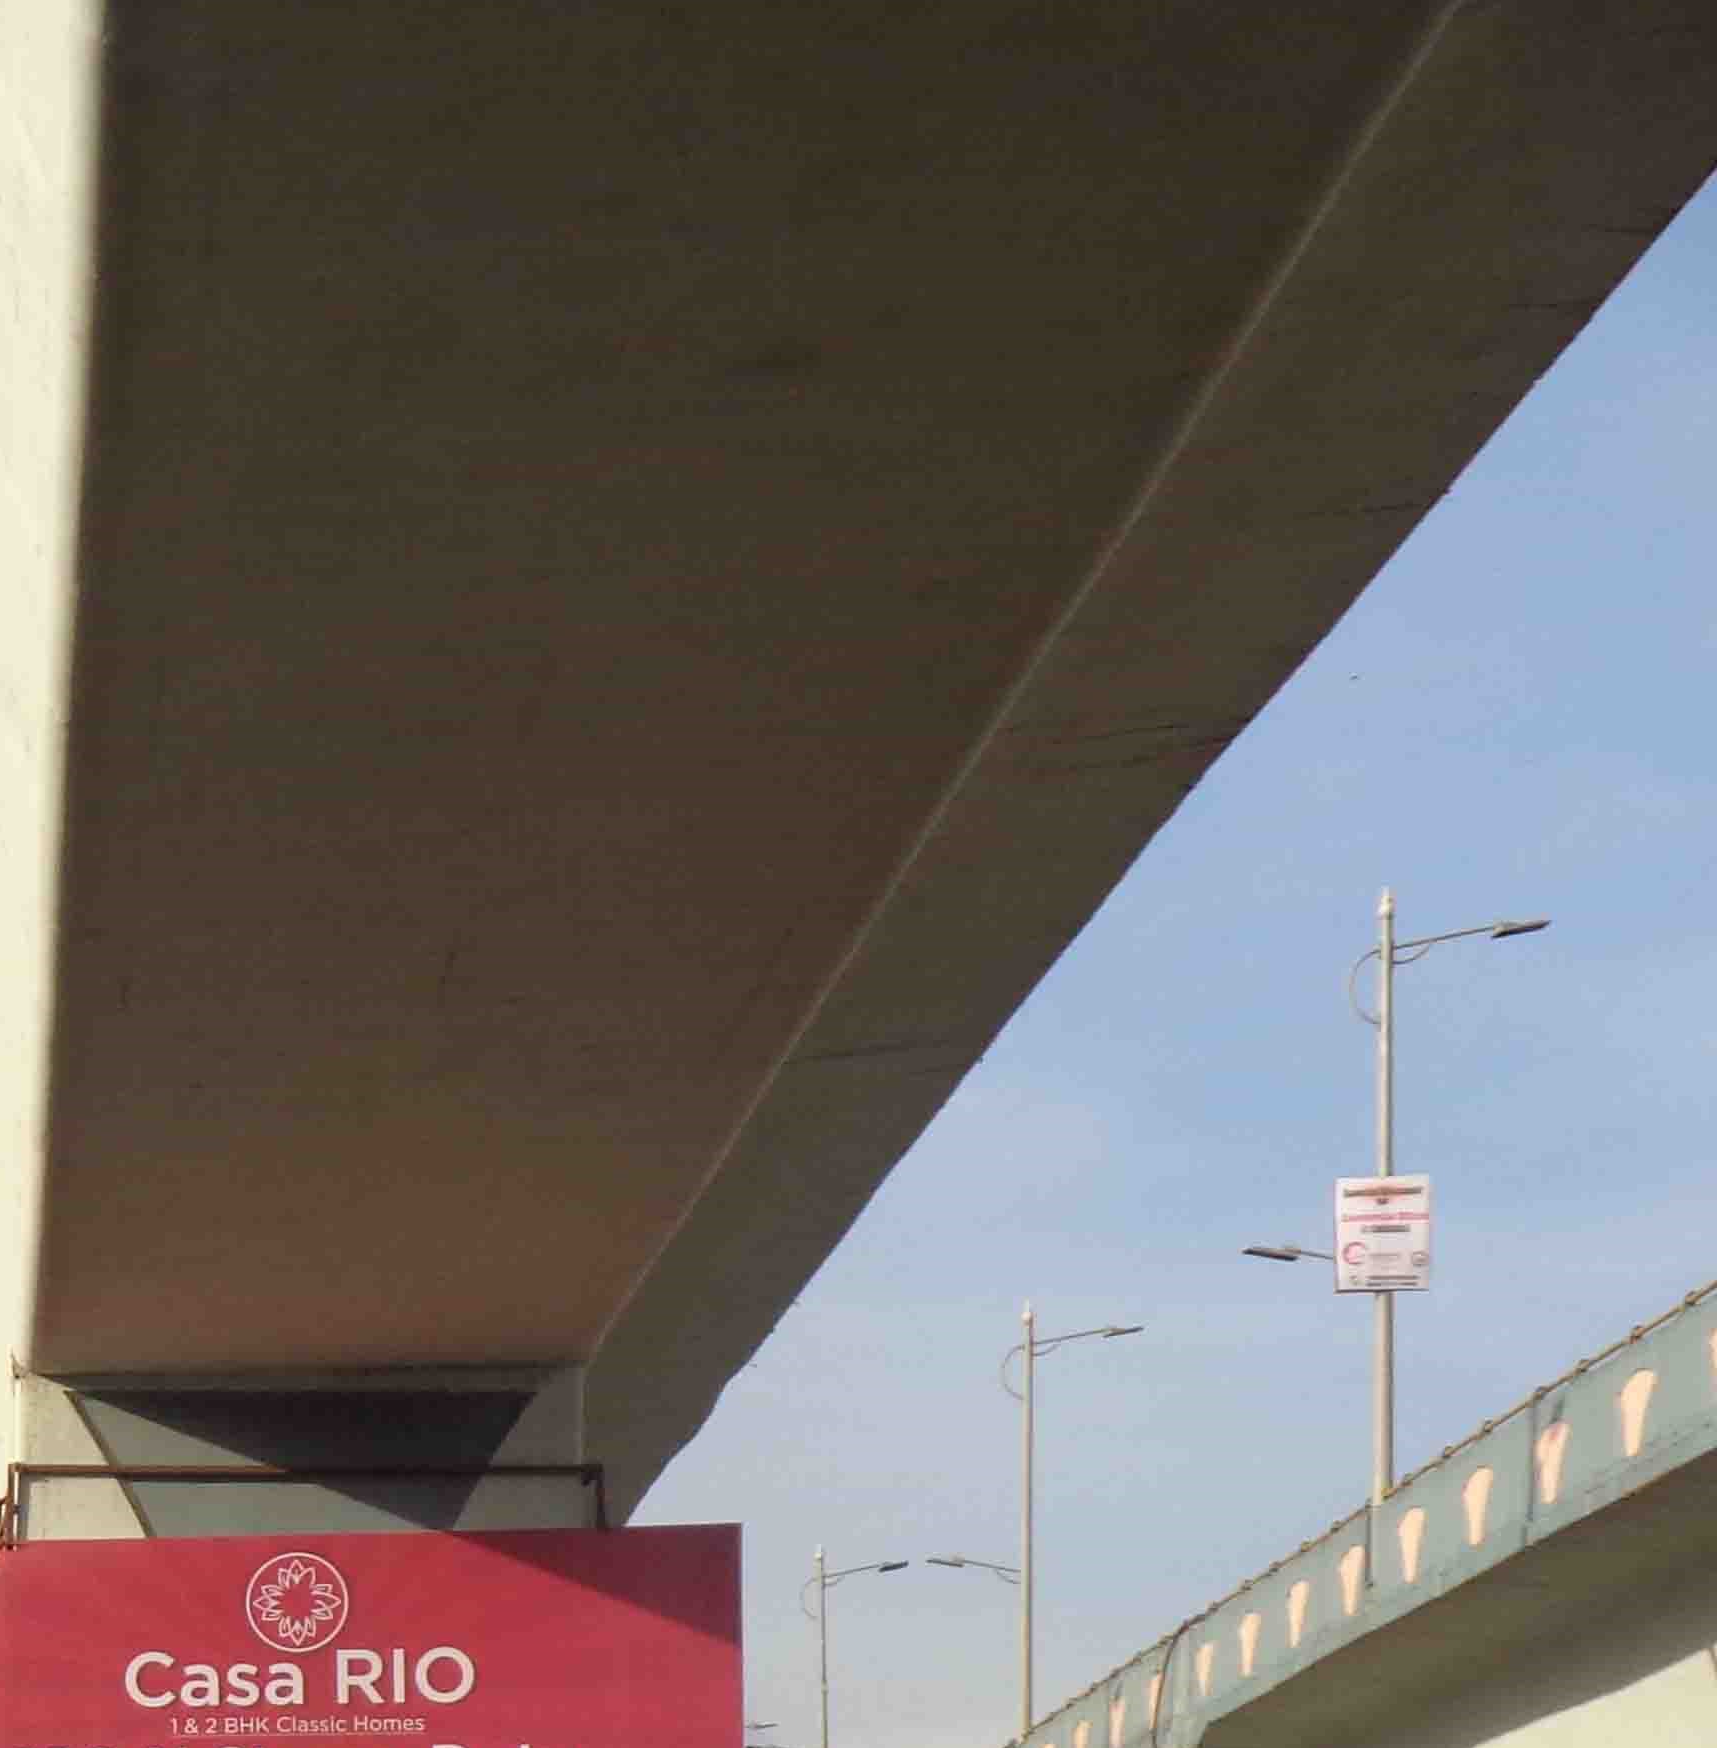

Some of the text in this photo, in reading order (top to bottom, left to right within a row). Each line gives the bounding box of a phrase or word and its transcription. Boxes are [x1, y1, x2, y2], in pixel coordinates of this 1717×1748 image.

[124, 1646, 476, 1708] Casa RIO
[170, 1714, 426, 1735] 1 & 2 BHK Classic Homes
